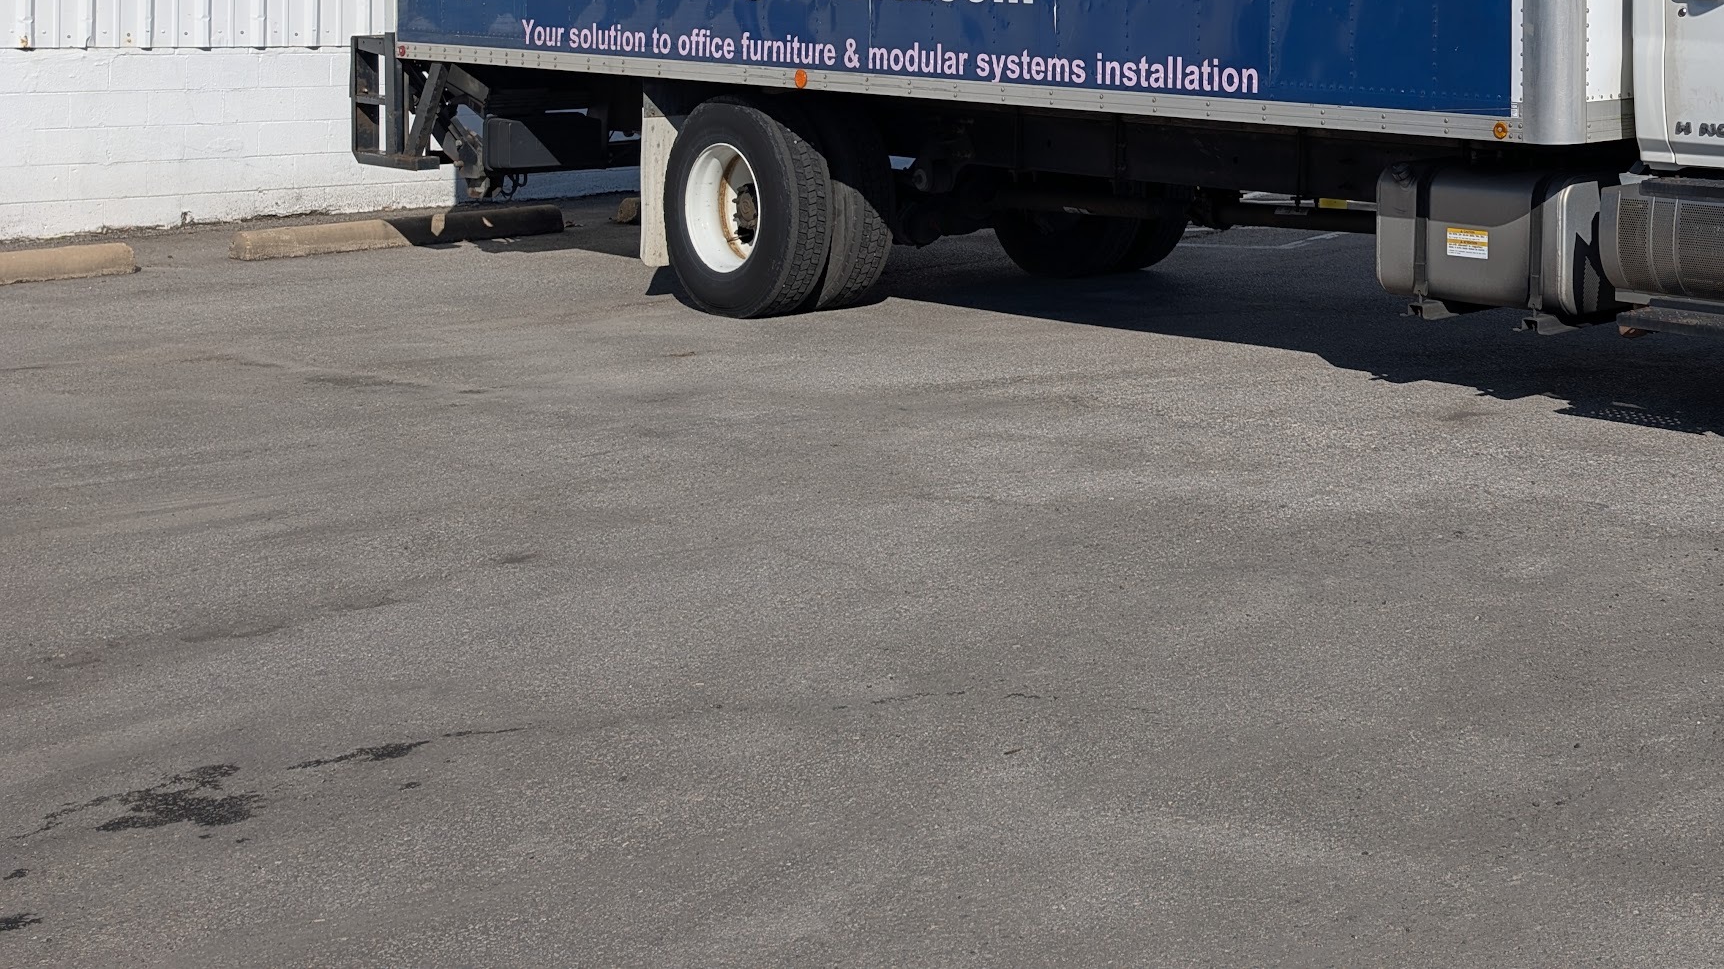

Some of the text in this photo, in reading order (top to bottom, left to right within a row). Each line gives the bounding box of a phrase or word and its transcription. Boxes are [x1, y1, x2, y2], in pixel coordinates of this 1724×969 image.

[521, 19, 1259, 95] Your solution to office furniture & modular systems installation
